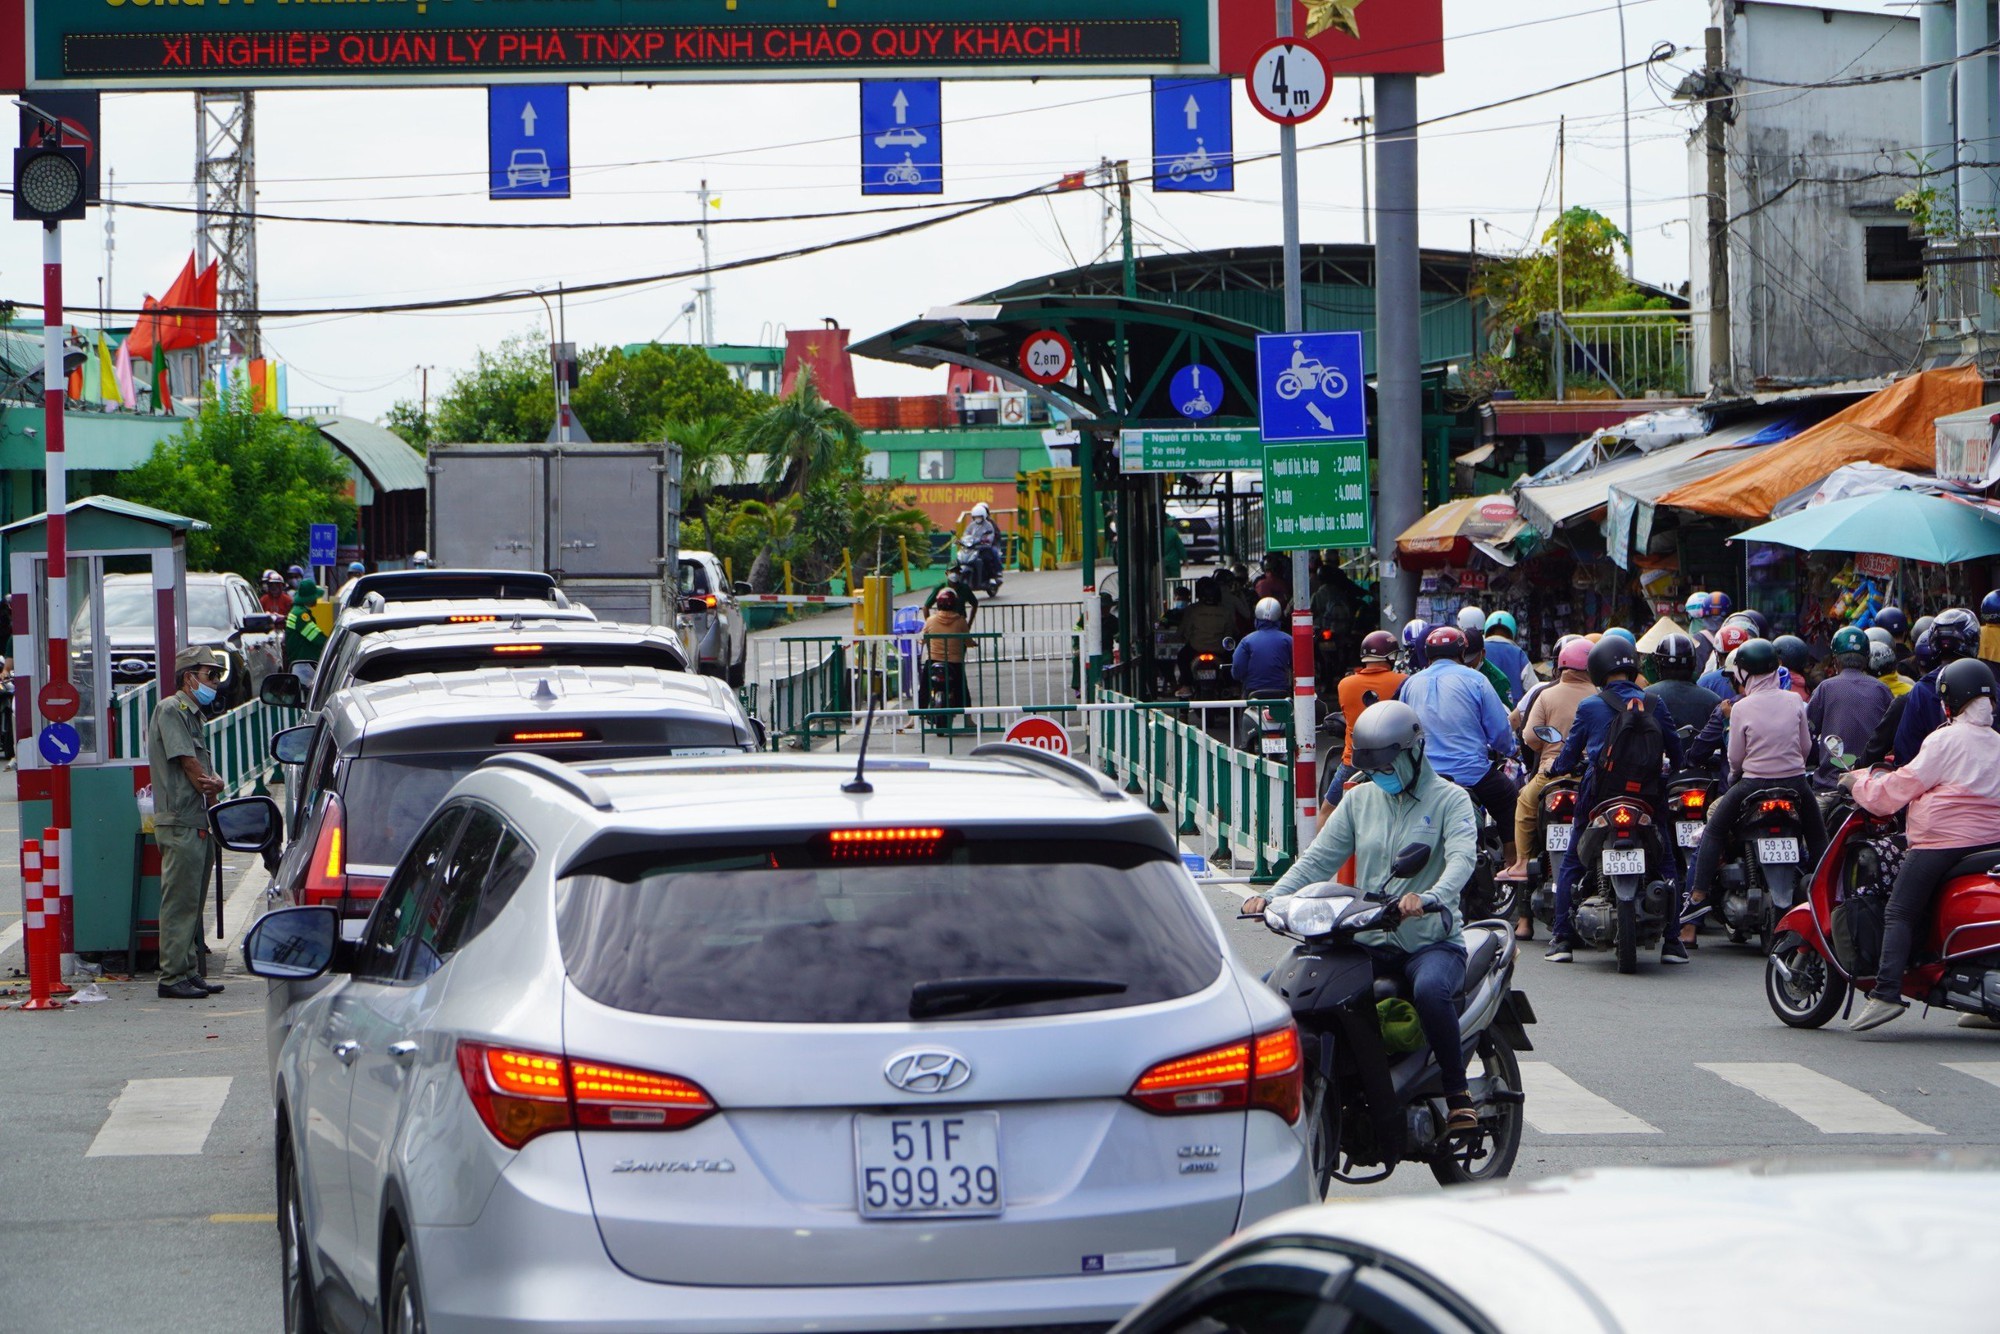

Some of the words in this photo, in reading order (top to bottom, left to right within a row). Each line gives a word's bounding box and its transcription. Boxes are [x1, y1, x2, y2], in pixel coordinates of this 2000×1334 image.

[574, 32, 665, 61] TNXP
[763, 25, 862, 58] CHÀO
[1210, 433, 1222, 442] Xe
[1152, 446, 1164, 455] Xe
[1166, 446, 1187, 456] máy
[1152, 459, 1164, 468] Xe
[1166, 459, 1186, 468] máy
[920, 487, 953, 503] XUNG
[955, 487, 994, 503] PHONG
[1274, 487, 1281, 504] Xe
[1281, 486, 1293, 505] máy
[1276, 516, 1283, 533] Xe
[1283, 515, 1294, 534] máy
[1765, 840, 1793, 851] 59-X3
[1762, 851, 1797, 862] 423.83
[1605, 862, 1643, 873] 358.06
[892, 1119, 964, 1162] 51F
[865, 1165, 998, 1208] 599.39
